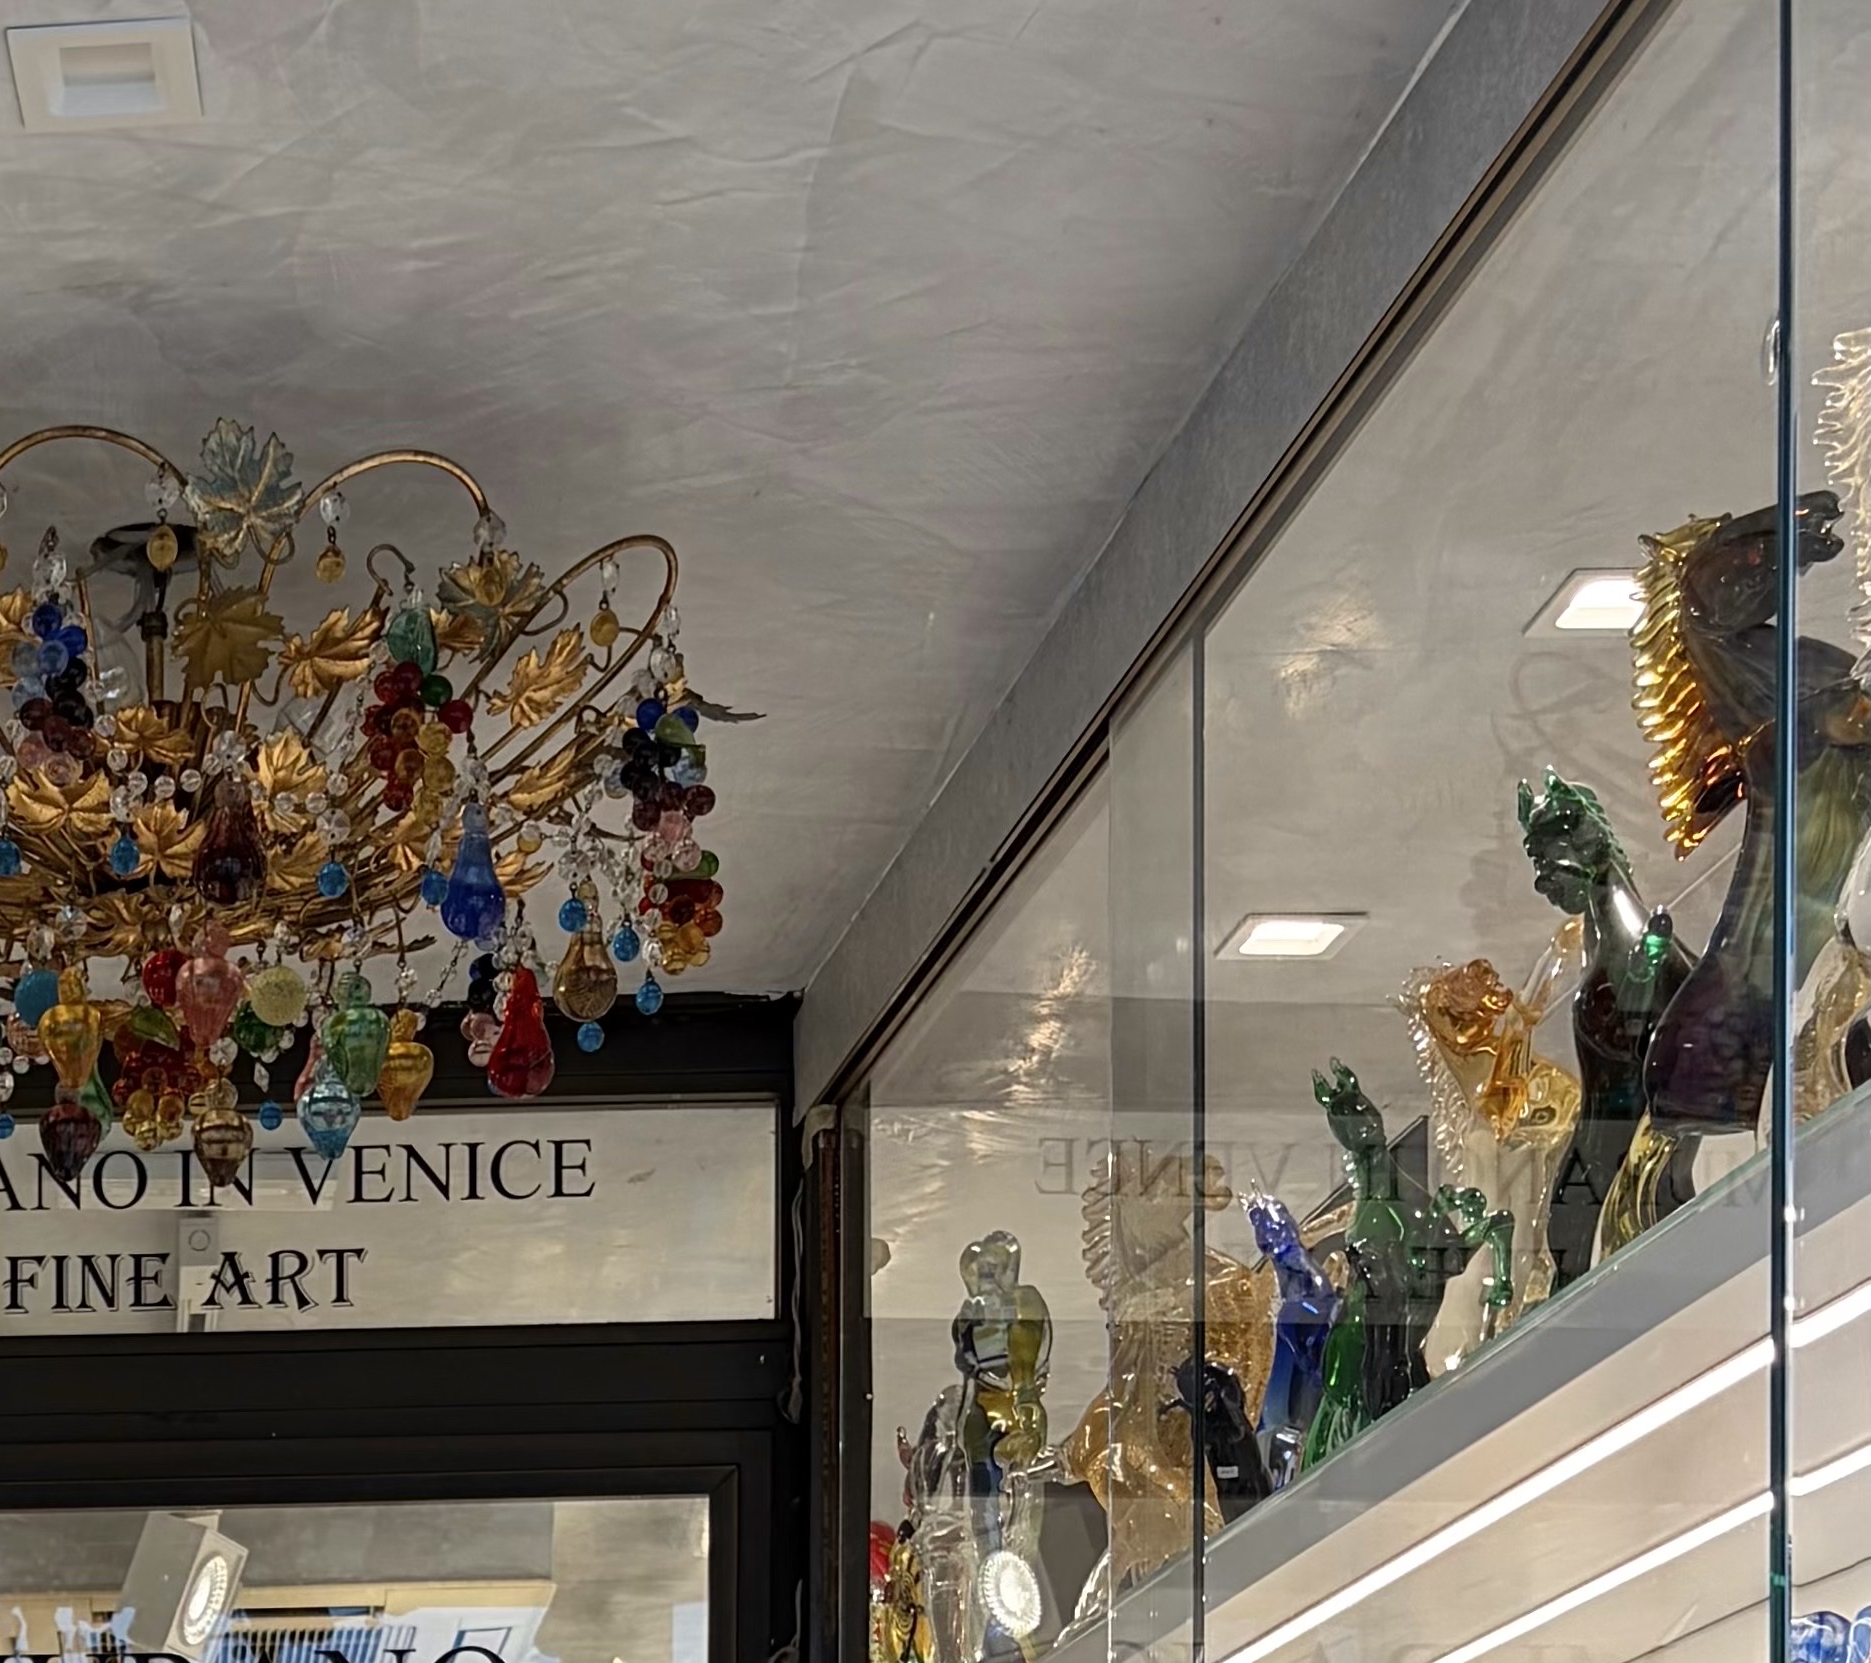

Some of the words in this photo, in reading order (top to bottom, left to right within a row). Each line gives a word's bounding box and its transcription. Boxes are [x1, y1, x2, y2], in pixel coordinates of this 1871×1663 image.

[284, 1138, 596, 1206] VENICE
[2, 1251, 177, 1315] FINE
[201, 1247, 369, 1313] ART
